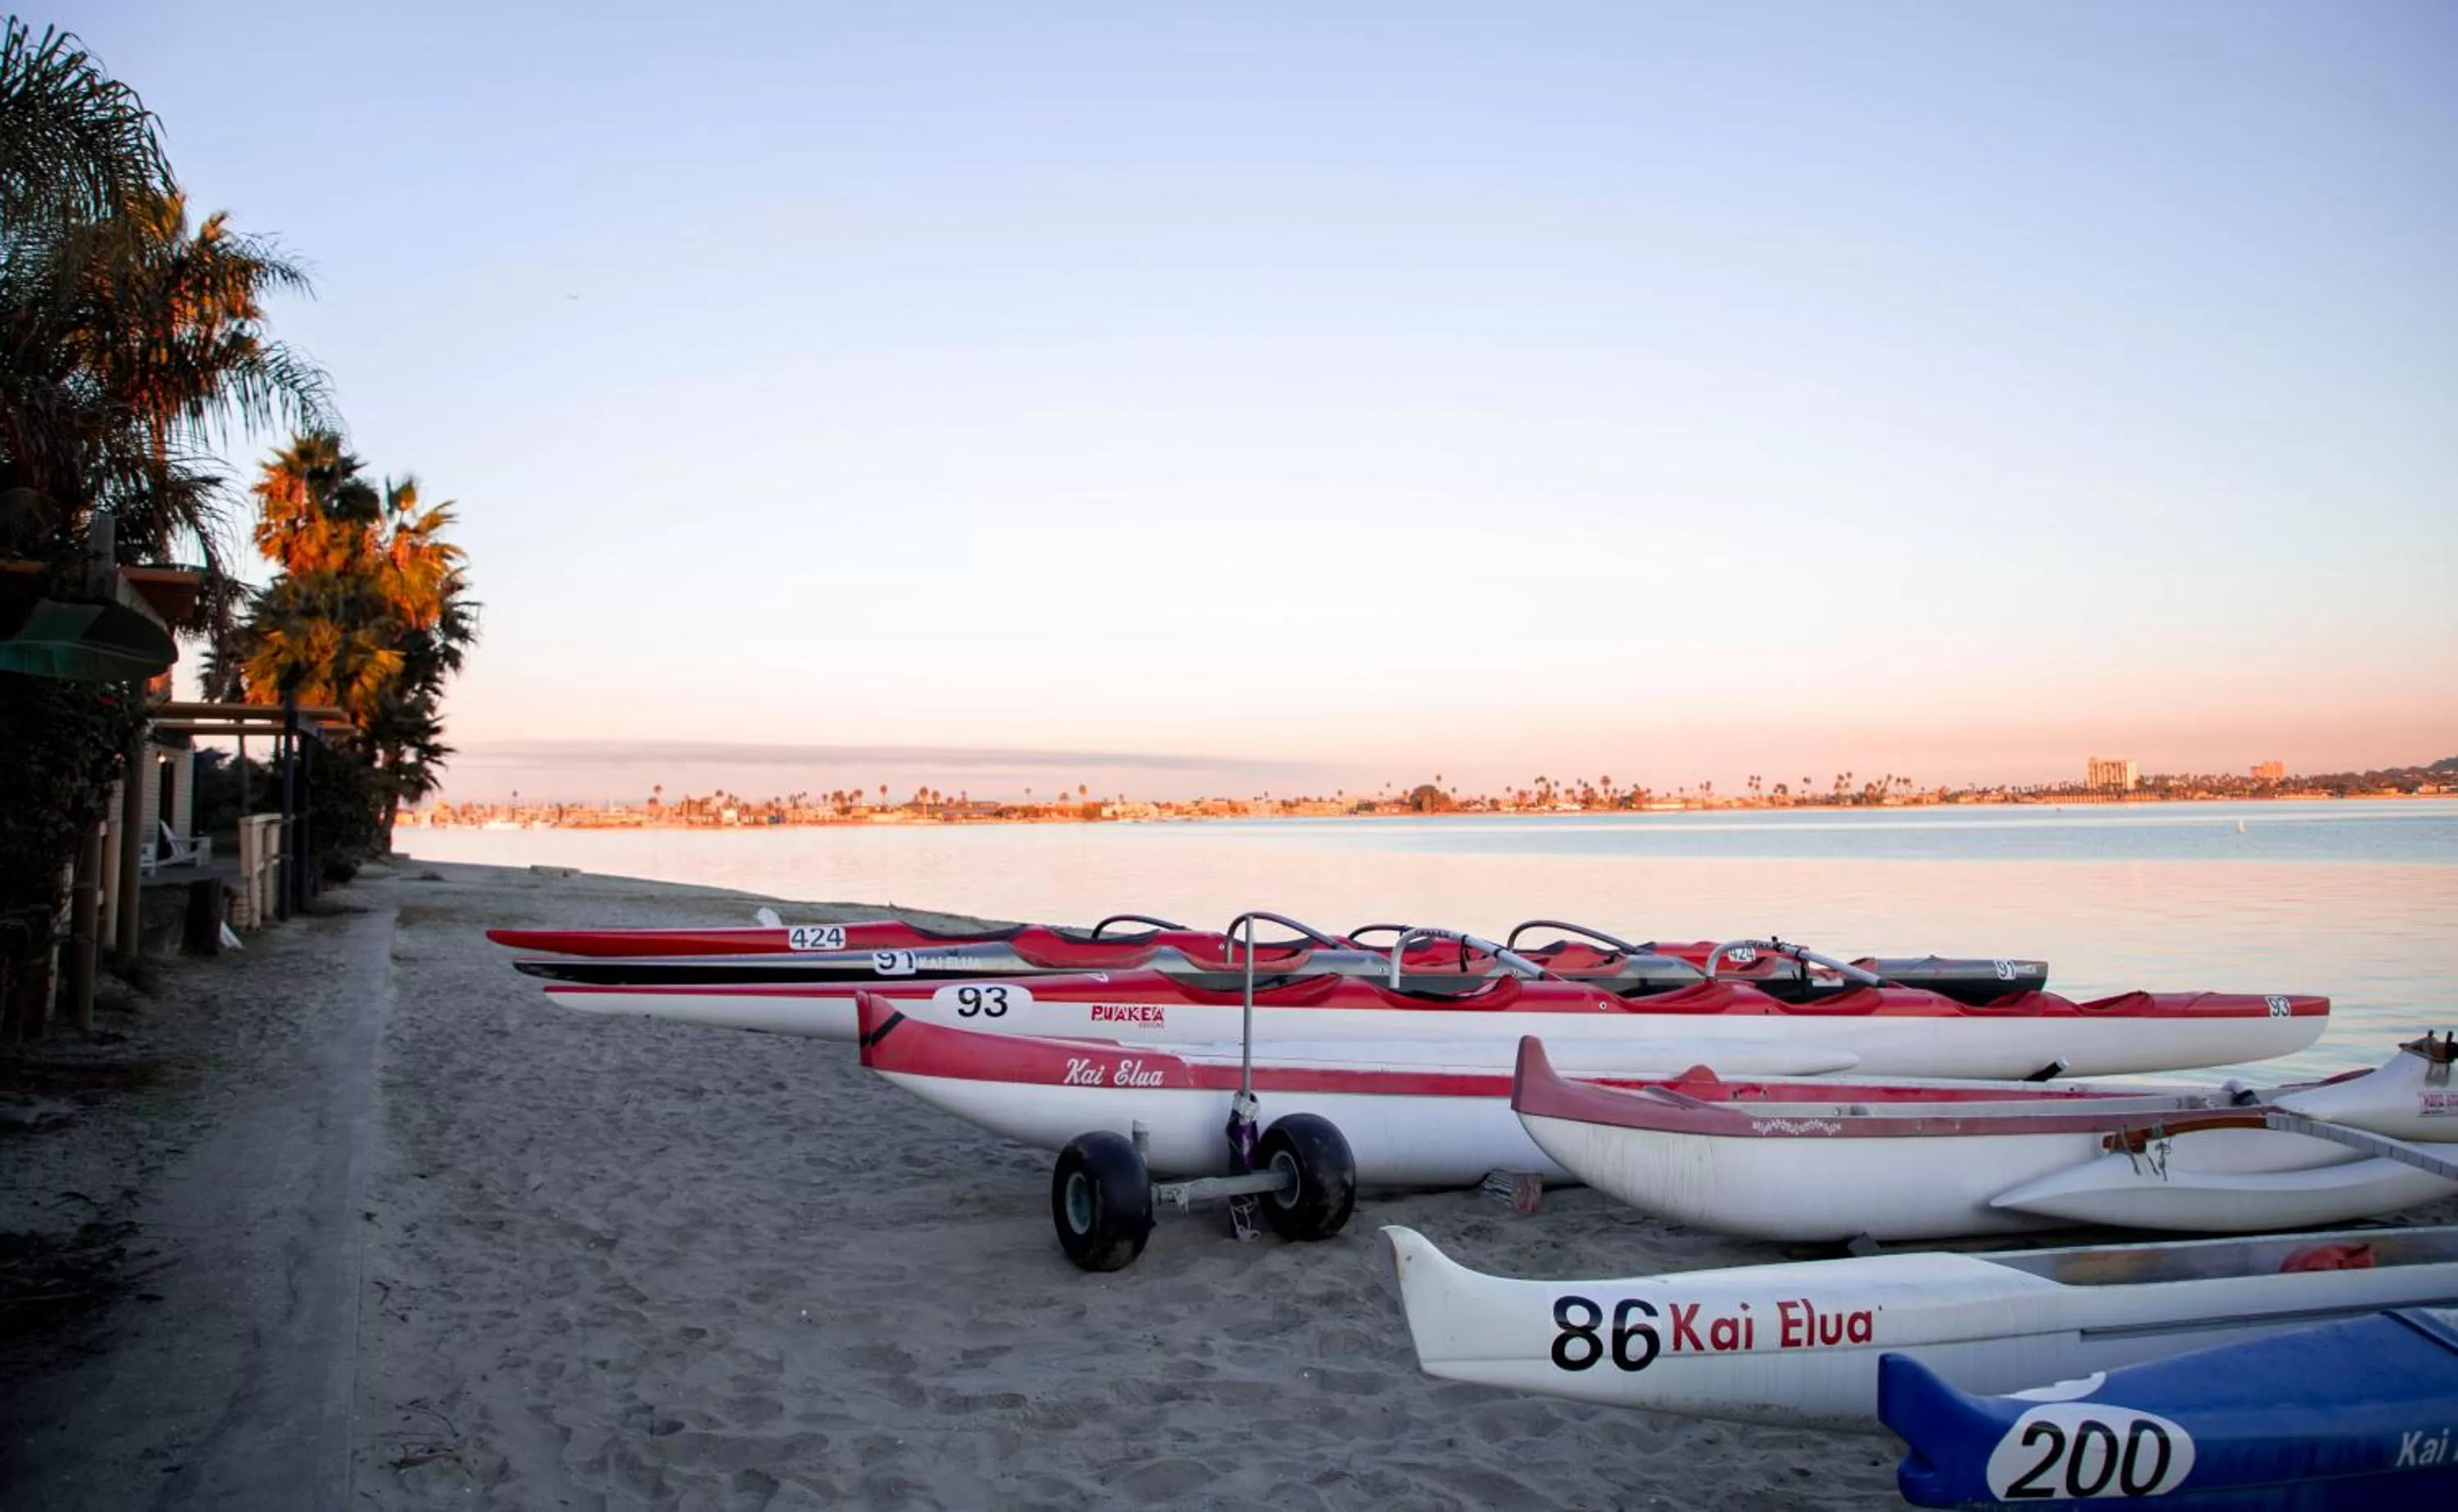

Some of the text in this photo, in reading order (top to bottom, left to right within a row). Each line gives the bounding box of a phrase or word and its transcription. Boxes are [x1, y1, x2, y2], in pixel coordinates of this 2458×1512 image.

[791, 927, 844, 948] 424
[877, 952, 914, 971] 91
[1996, 960, 2016, 977] 91
[957, 986, 1009, 1018] 93
[1091, 1004, 1164, 1022] PUAKEA
[2266, 996, 2290, 1016] 93
[1063, 1057, 1164, 1087] Kai Elua
[1550, 1294, 1873, 1372] 86 Kai Elua
[2005, 1419, 2171, 1499] 200
[2395, 1428, 2450, 1468] Kai
